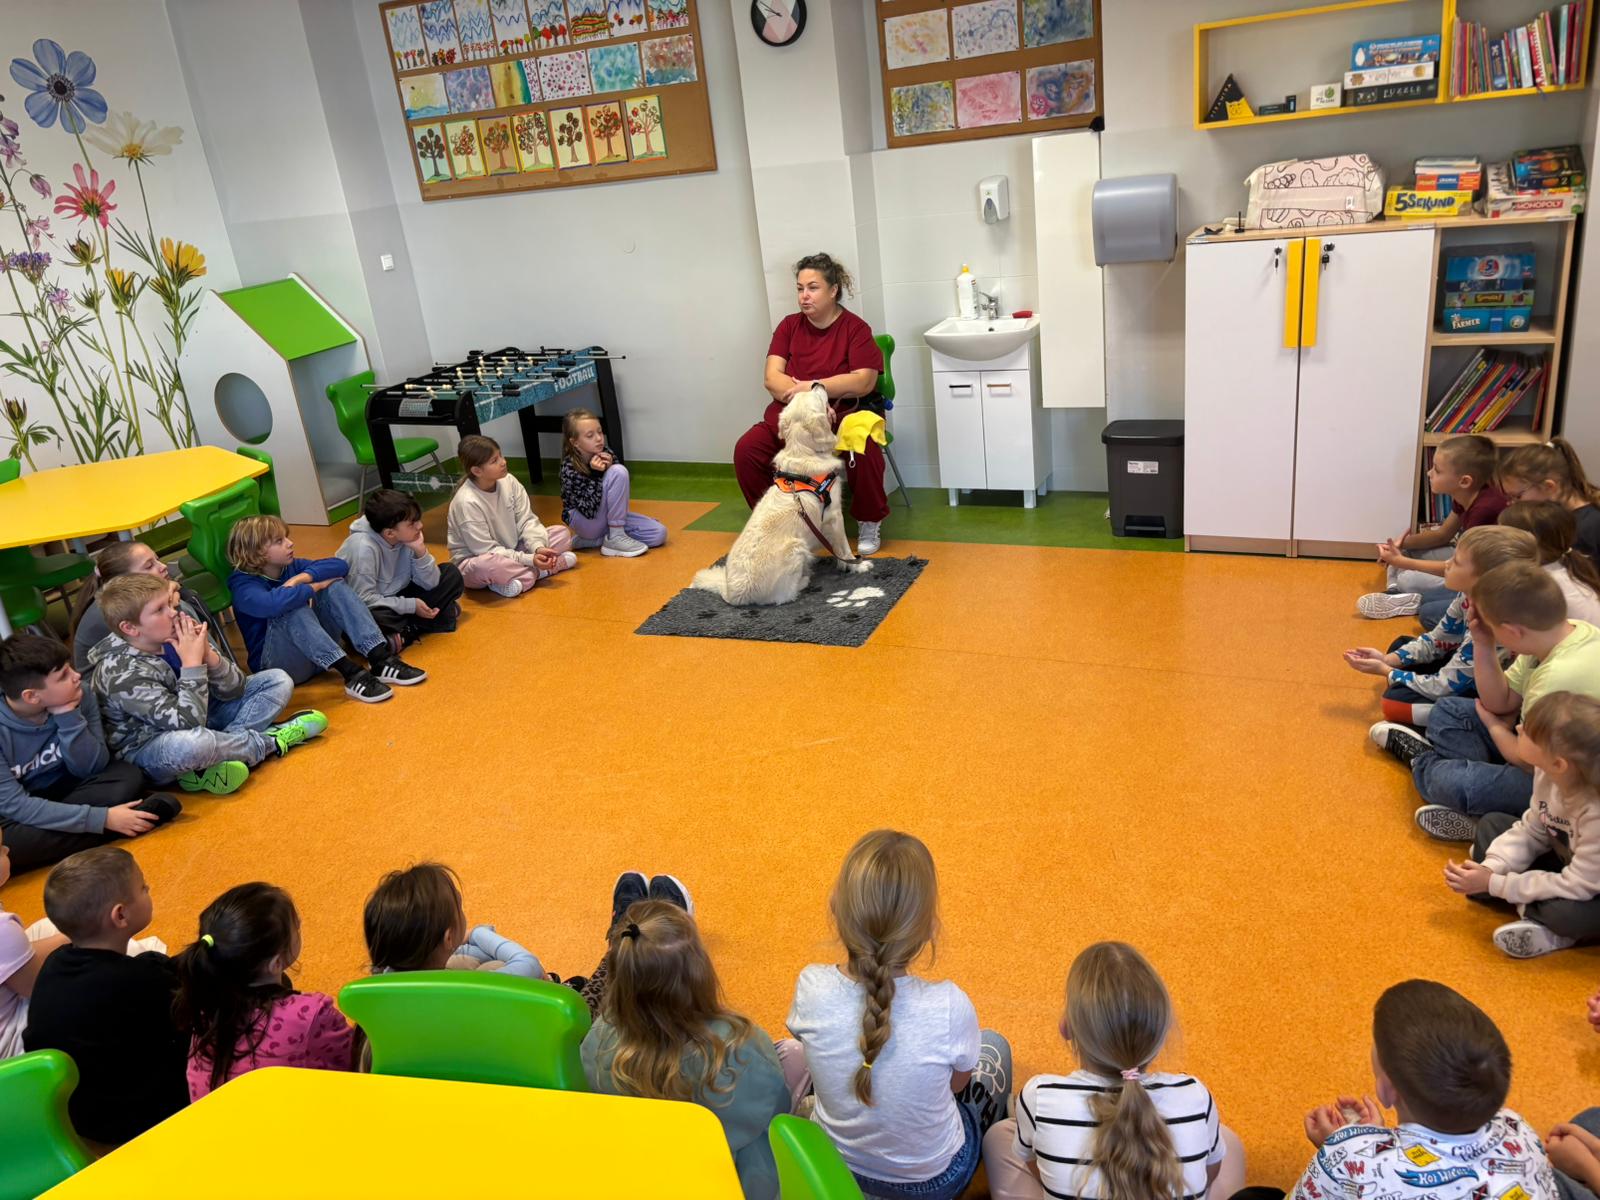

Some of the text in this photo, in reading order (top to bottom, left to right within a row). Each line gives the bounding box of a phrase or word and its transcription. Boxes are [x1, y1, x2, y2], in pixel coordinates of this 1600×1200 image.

[1383, 86, 1422, 98] PUZZLE
[1394, 193, 1408, 211] 5
[1517, 200, 1561, 210] MONOPOLY
